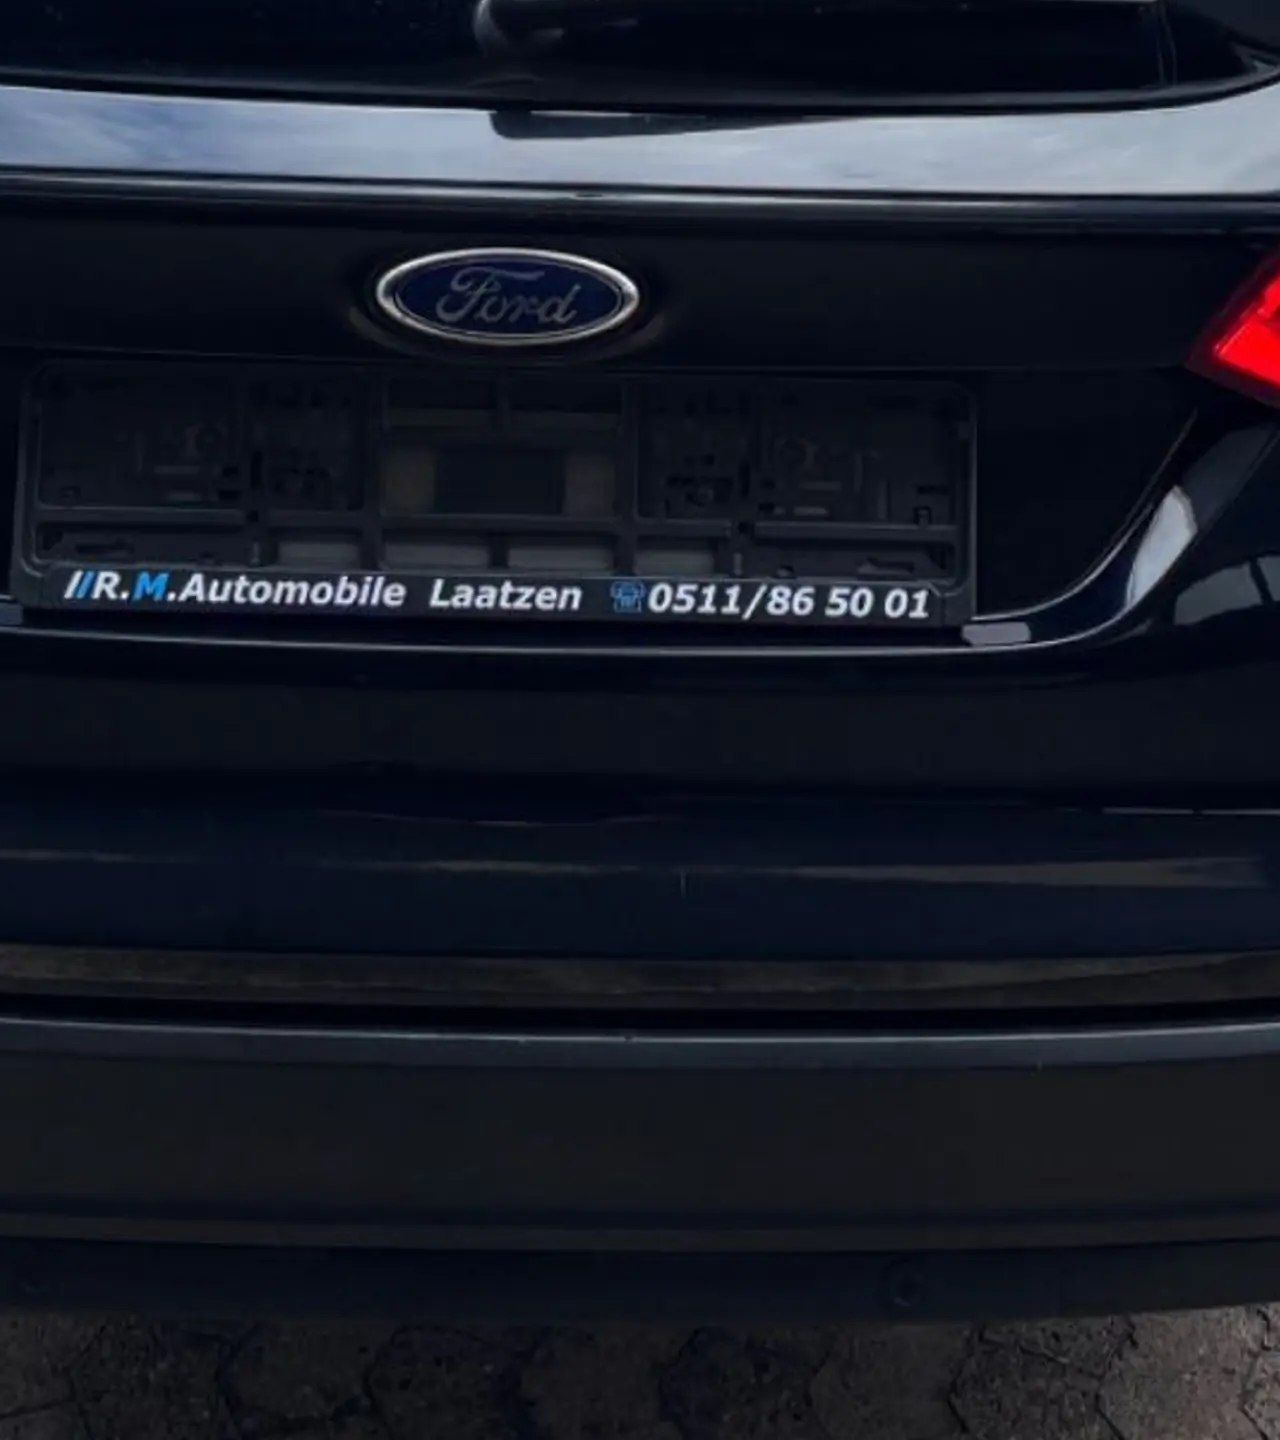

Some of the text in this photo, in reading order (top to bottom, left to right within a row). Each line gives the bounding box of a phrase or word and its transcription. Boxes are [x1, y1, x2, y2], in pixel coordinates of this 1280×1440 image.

[435, 265, 581, 324] Ford
[429, 577, 582, 612] Laatzen
[648, 582, 815, 621] 0511/86
[825, 587, 874, 618] 50
[885, 587, 930, 620] 01
